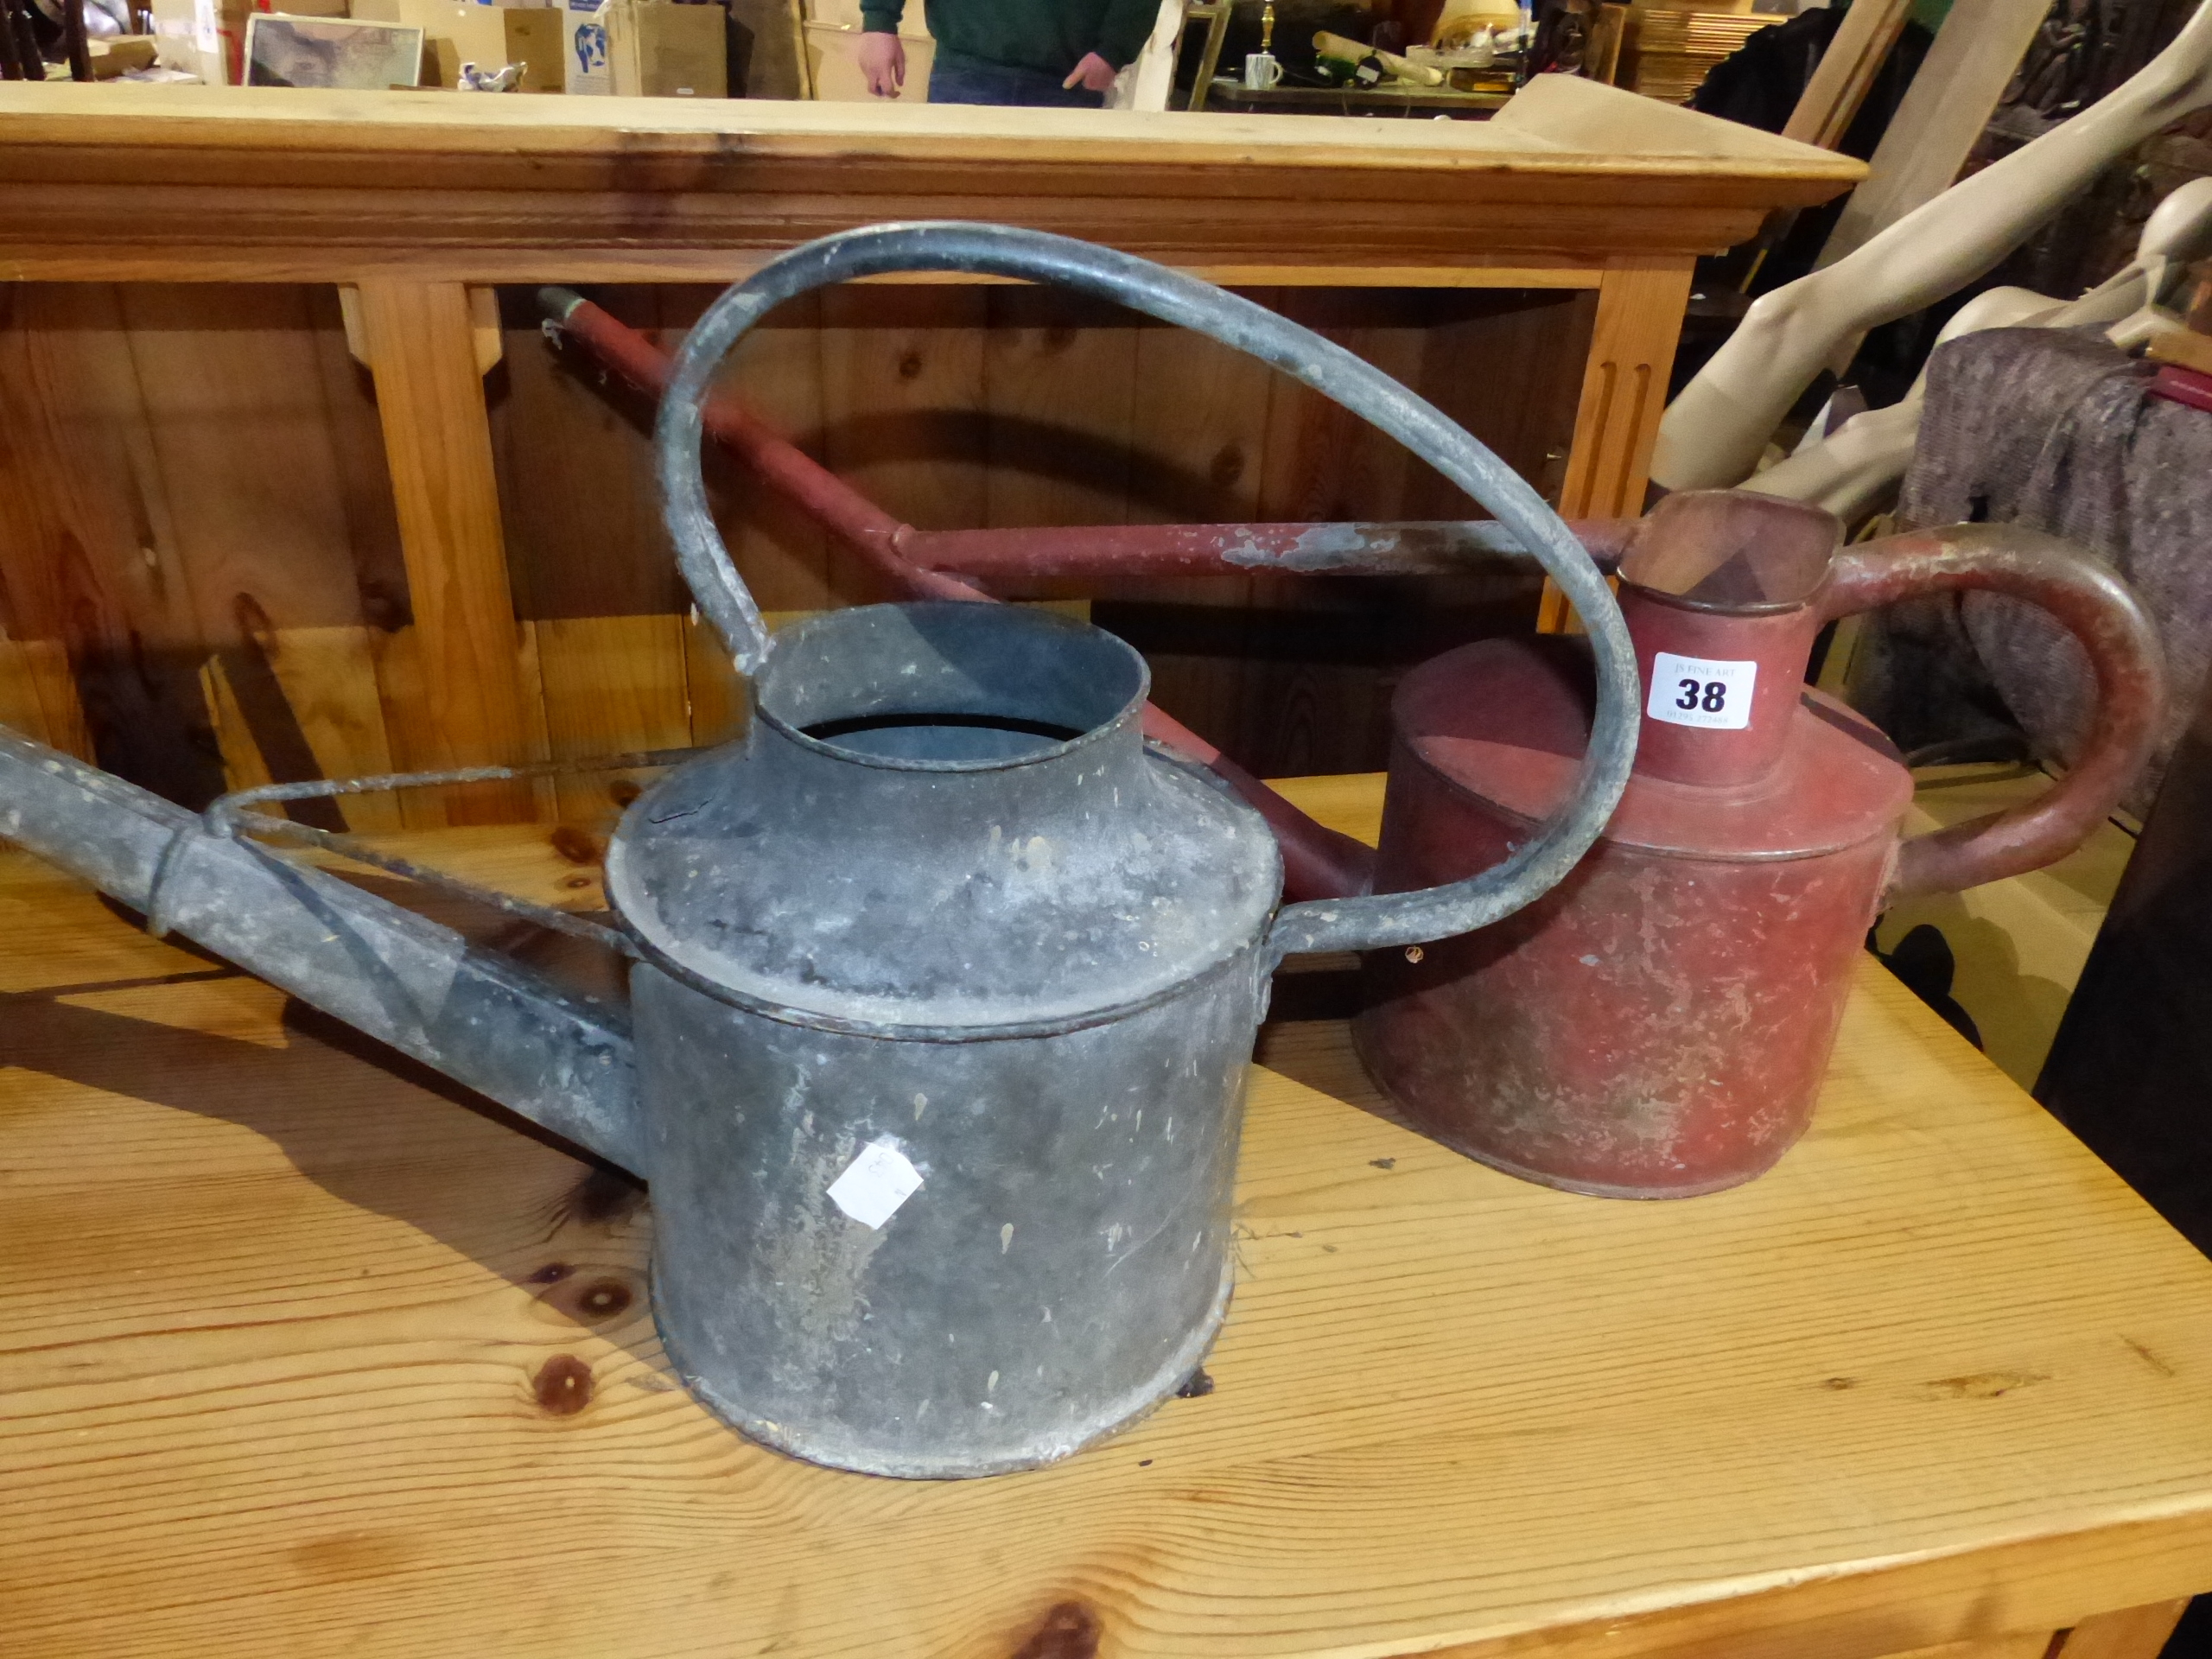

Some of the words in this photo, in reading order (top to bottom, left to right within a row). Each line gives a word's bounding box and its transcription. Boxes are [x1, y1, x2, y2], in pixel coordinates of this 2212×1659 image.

[1675, 663, 1685, 674] JS
[1688, 664, 1712, 677] FINE
[1715, 668, 1735, 677] ART
[1675, 678, 1726, 713] 38
